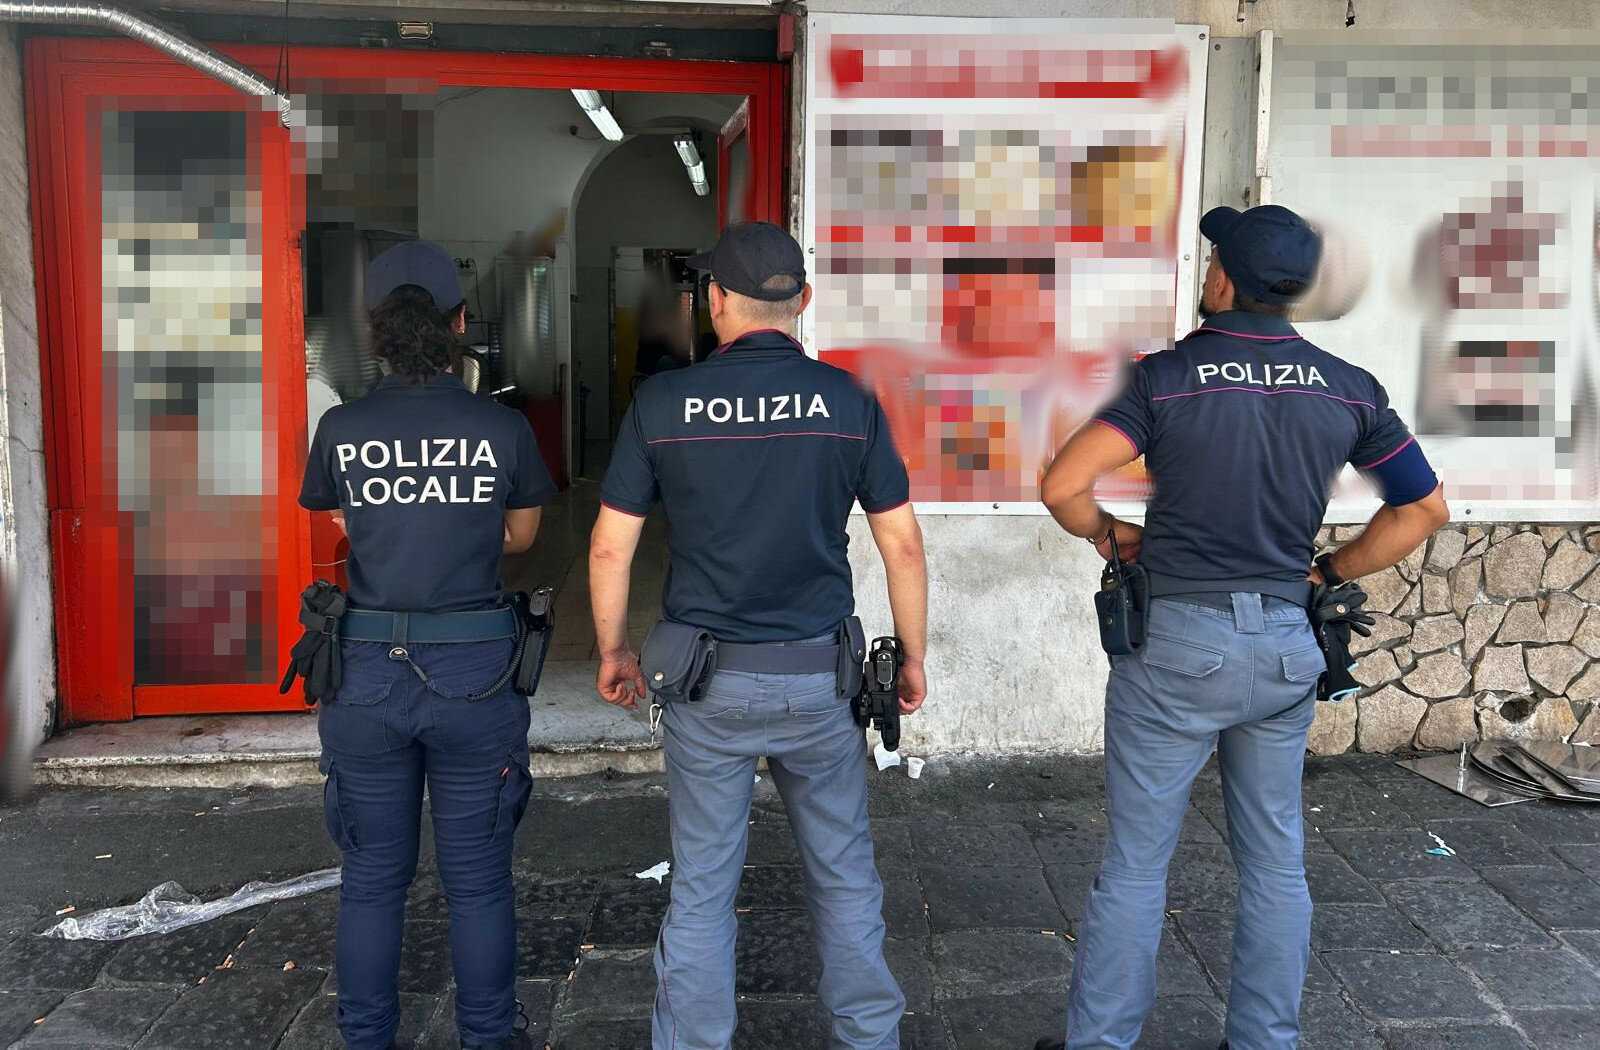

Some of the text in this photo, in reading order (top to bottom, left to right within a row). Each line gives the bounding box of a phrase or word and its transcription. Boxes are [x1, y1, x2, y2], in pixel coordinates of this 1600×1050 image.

[1196, 362, 1329, 388] POLIZIA
[684, 393, 830, 423] POLIZIA
[336, 438, 498, 472] POLIZIA
[345, 475, 496, 507] LOCALE
